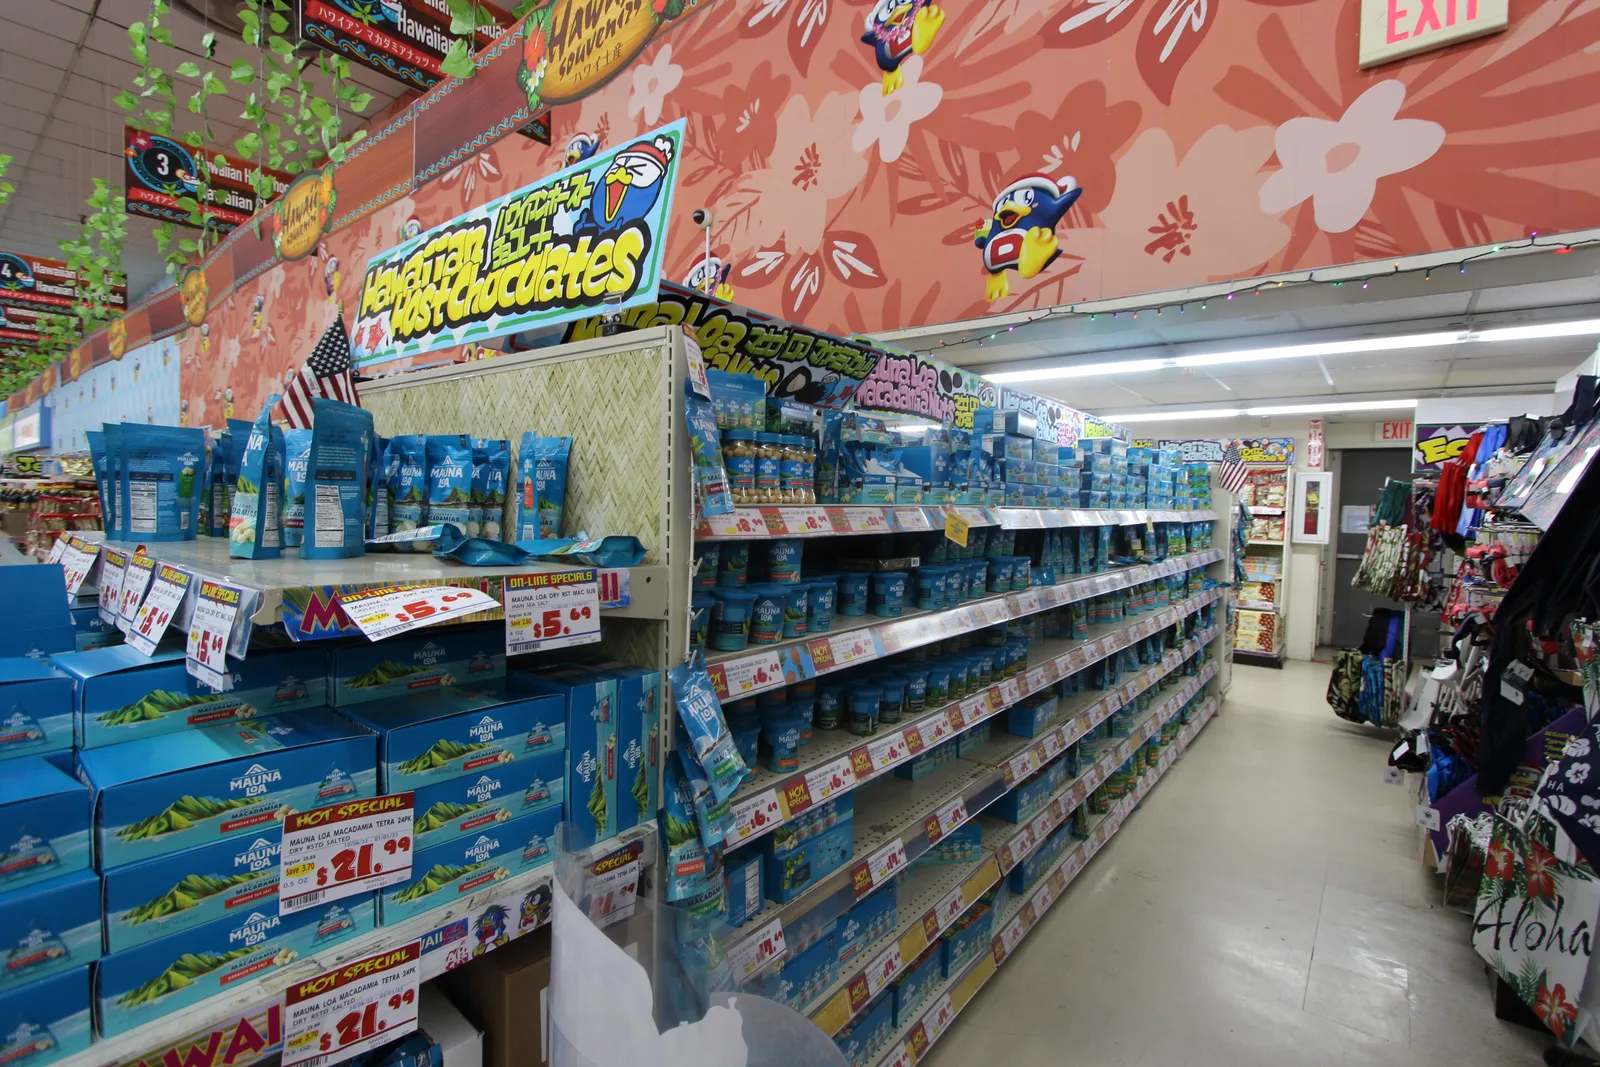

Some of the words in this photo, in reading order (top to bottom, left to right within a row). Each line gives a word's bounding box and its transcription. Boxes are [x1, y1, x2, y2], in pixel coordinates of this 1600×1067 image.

[318, 6, 363, 35] ハワイアン
[156, 153, 170, 176] 3
[361, 224, 487, 317] Hawaiian
[391, 274, 452, 338] Host
[446, 227, 645, 322] Chocolates
[1382, 421, 1412, 440] EXIT
[430, 466, 463, 479] MAUNA
[438, 477, 450, 488] LOA
[510, 575, 549, 589] ON-LINE
[550, 571, 593, 585] SPECIALS
[341, 587, 397, 603] ON-LINE
[511, 595, 534, 603] MAUNA
[572, 589, 585, 597] MAC
[586, 587, 596, 595] SUB
[395, 591, 473, 624] $5.69
[533, 606, 591, 639] $5.69
[760, 614, 773, 622] LOA
[413, 648, 447, 660] MAUNA
[813, 645, 828, 656] HOT
[423, 657, 437, 665] LOA
[752, 663, 779, 685] $6.49
[469, 722, 504, 738] MAUNA
[480, 733, 494, 743] LOA
[629, 738, 637, 770] MAUNA
[854, 753, 868, 766] HOT
[229, 769, 282, 791] MAUNA
[830, 768, 851, 789] $6.49
[245, 785, 268, 798] LOA
[467, 780, 502, 798] MAUNA
[477, 793, 492, 802] LOA
[790, 783, 804, 799] HOT
[790, 794, 810, 808] SPECIAL
[231, 803, 283, 820] MACADAMIAS
[296, 808, 335, 828] HOT
[337, 796, 407, 818] SPECIAL
[750, 801, 778, 829] $6.49
[289, 836, 316, 847] MAUNA
[317, 832, 331, 842] LOA
[333, 822, 374, 837] MACADAMIA
[376, 817, 395, 829] TETRA
[397, 815, 412, 825] 24PK
[289, 846, 303, 855] DRY
[306, 842, 324, 851] RSTD
[326, 835, 351, 847] SALTED
[465, 842, 500, 859] MAUNA
[249, 857, 271, 871] LOA
[283, 857, 301, 866] Regular
[316, 836, 411, 886] $21.99
[475, 853, 490, 863] LOA
[595, 853, 633, 874] SPECIAL
[285, 867, 300, 877] Save
[301, 862, 315, 872] 3.70
[283, 880, 295, 889] 0.5
[298, 876, 309, 885] OZ
[229, 914, 281, 942] MAUNA
[1471, 891, 1592, 957] Aloha
[245, 933, 267, 947] LOA
[230, 947, 282, 971] MACADAMIAS
[299, 971, 340, 998] HOT
[342, 948, 411, 980] SPECIAL
[292, 1004, 320, 1019] MAUNA
[322, 996, 337, 1007] LOA
[338, 980, 379, 1001] MACADAMIA
[381, 973, 400, 985] TETRA
[402, 966, 416, 977] 24PK
[292, 1016, 308, 1027] DRY
[311, 1008, 329, 1021] RSTD
[331, 997, 356, 1012] SALTED
[319, 988, 416, 1052] $21.99
[287, 1037, 303, 1047] Save
[304, 1030, 319, 1041] 3.70
[299, 1044, 312, 1052] OZ
